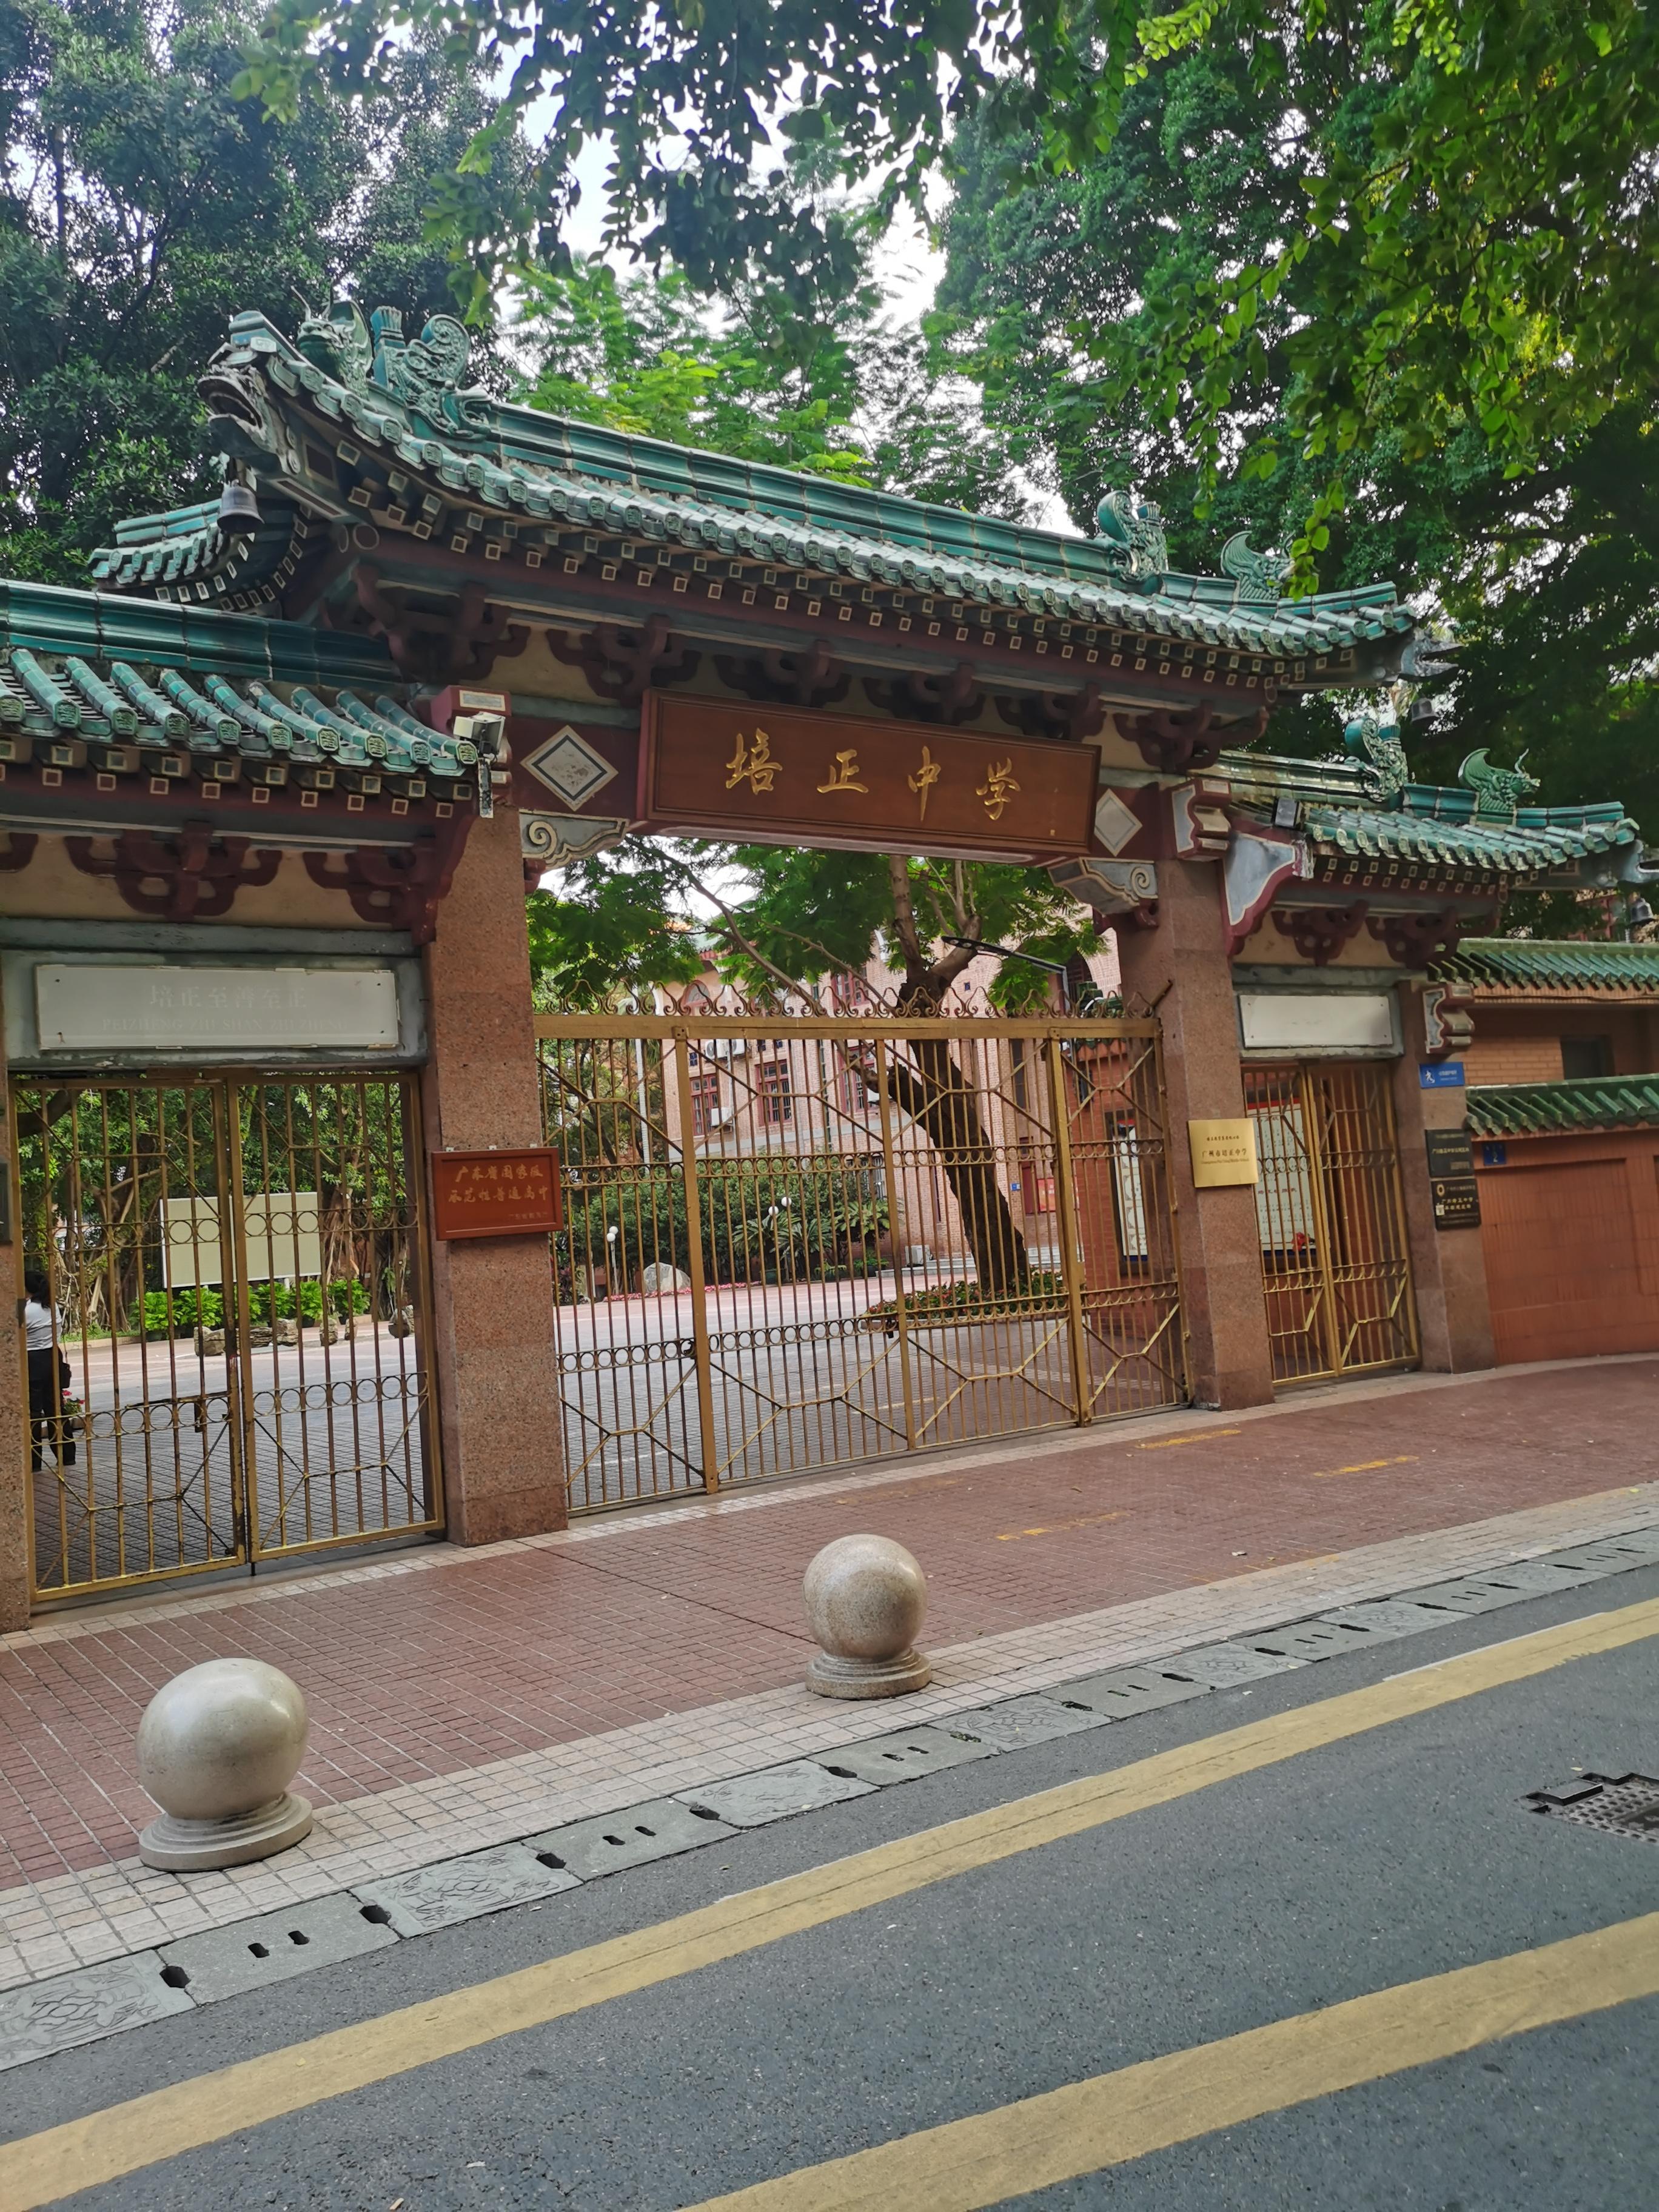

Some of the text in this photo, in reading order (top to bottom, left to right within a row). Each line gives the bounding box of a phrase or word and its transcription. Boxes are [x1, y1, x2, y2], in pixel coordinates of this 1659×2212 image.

[725, 727, 1021, 822] 培正中学
[455, 1163, 543, 1183] 广东省国家级
[448, 1185, 548, 1203] 示范性普通高中
